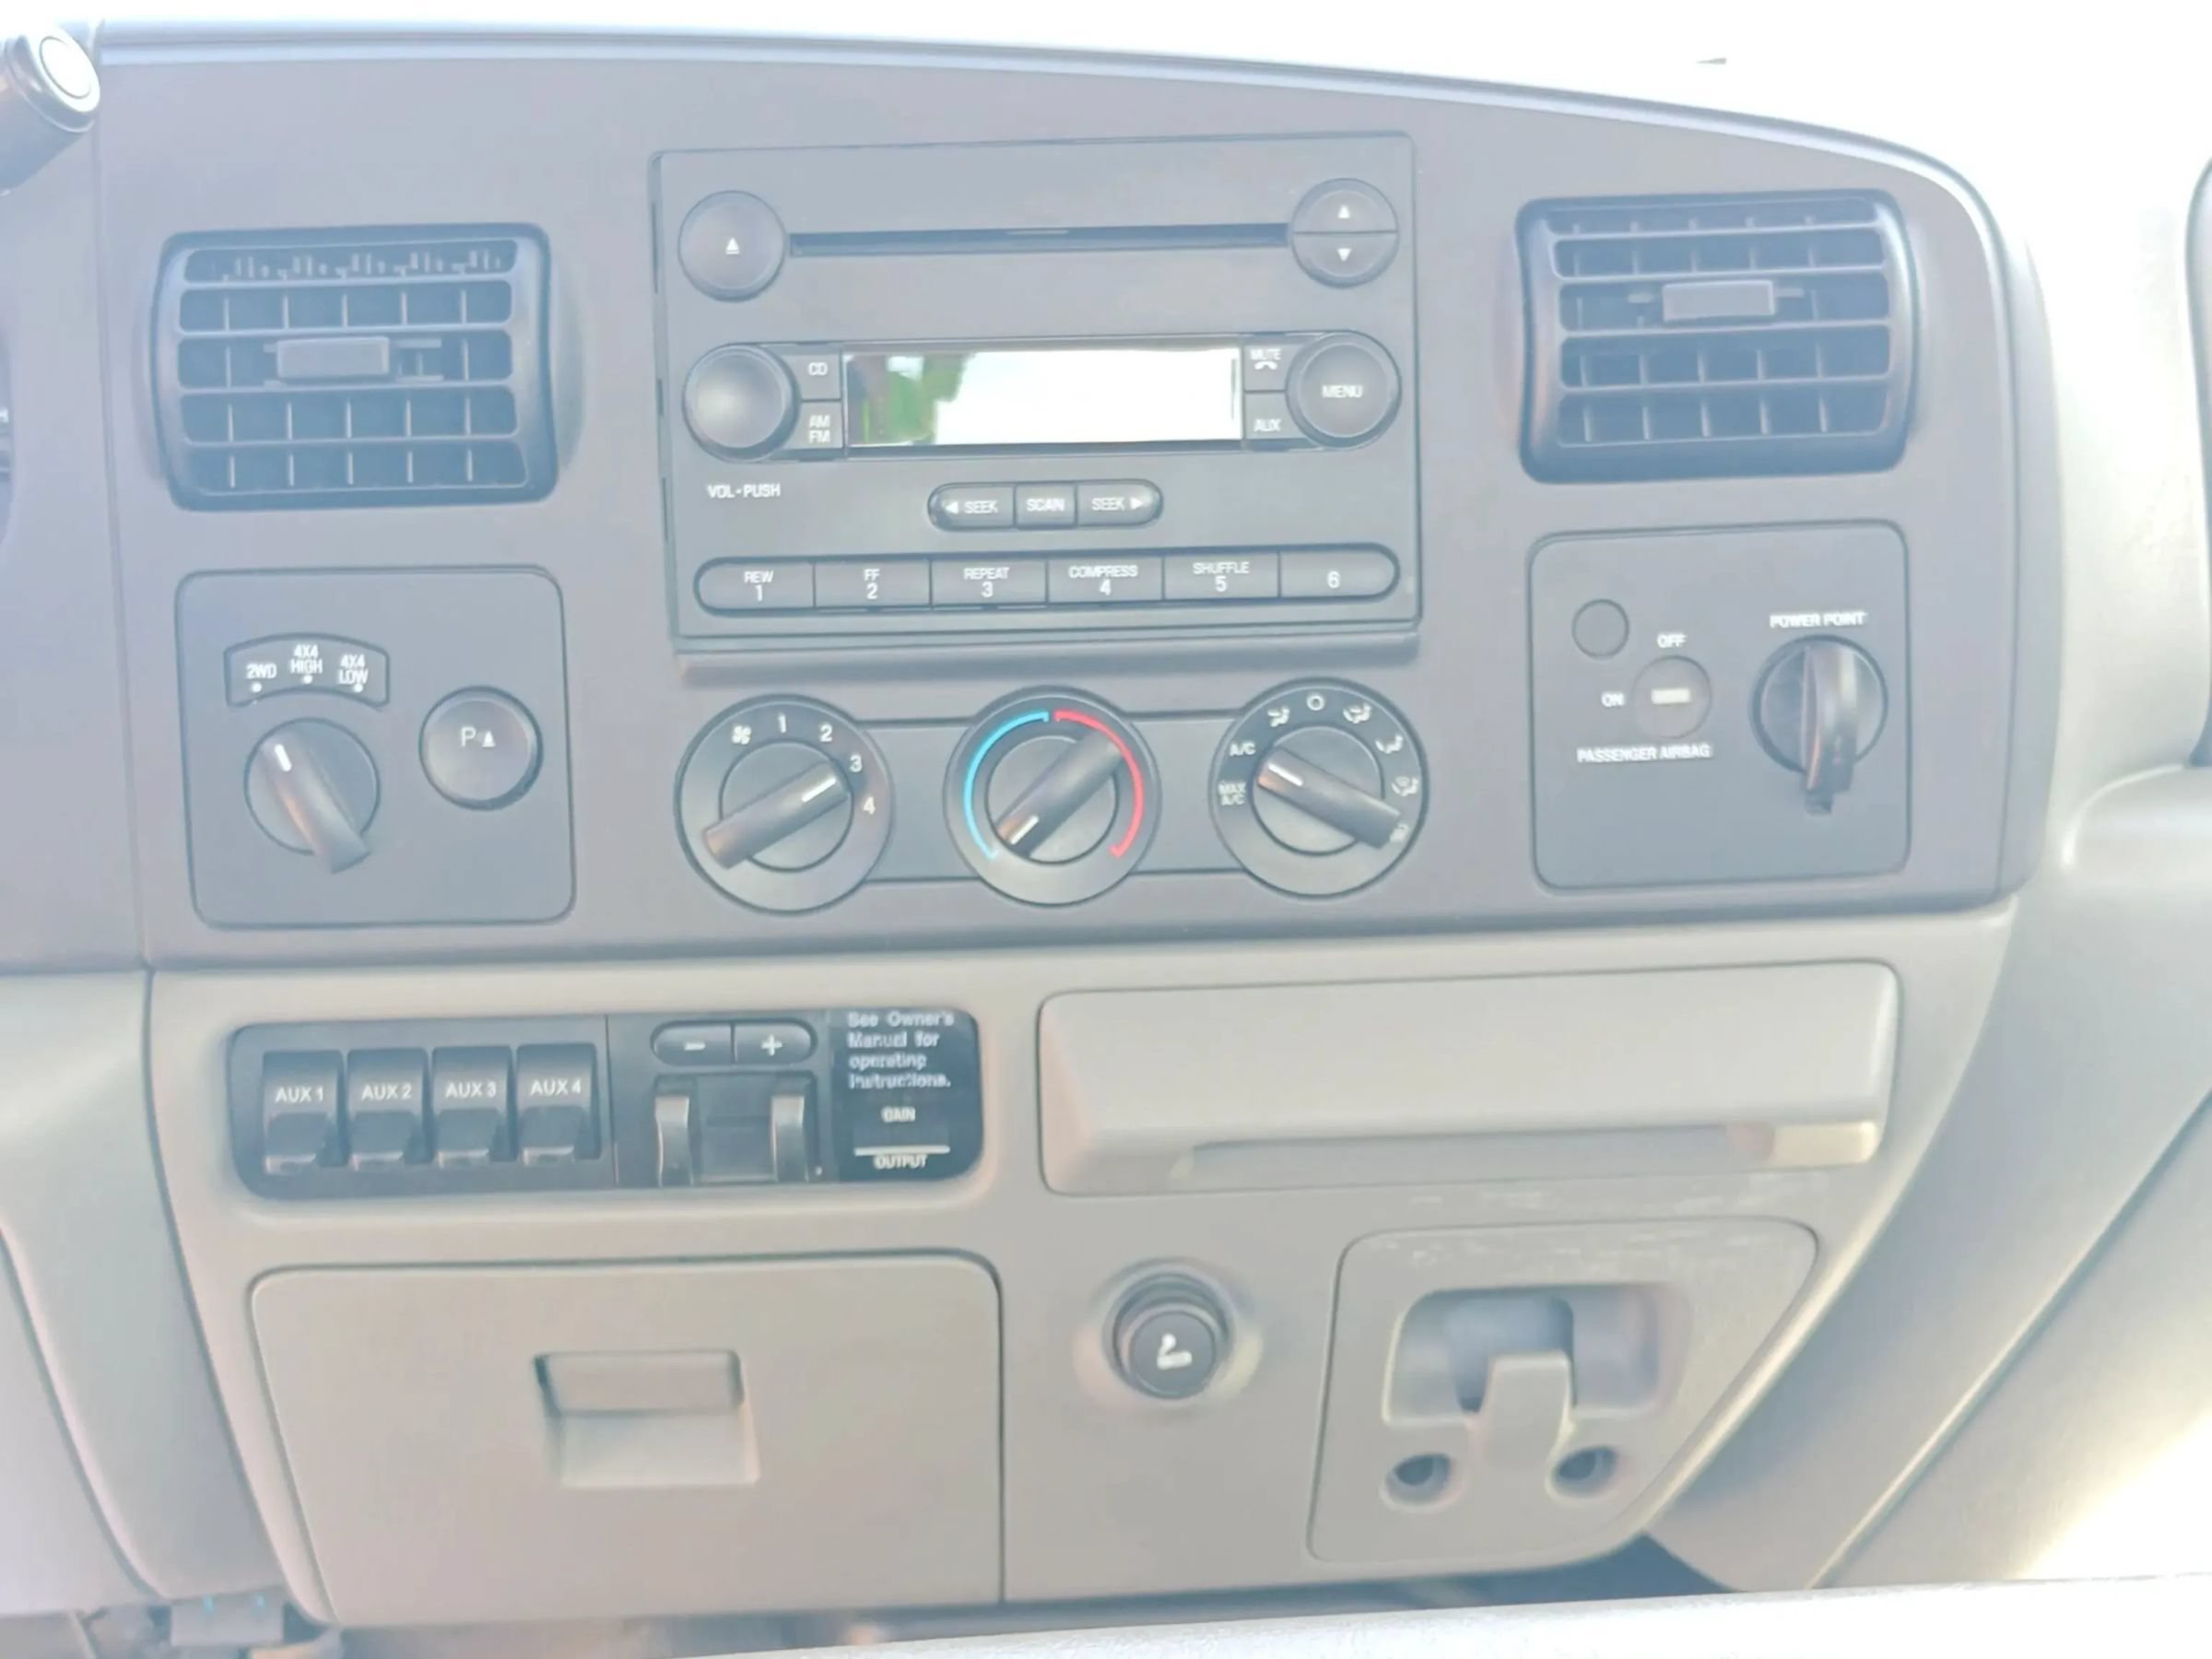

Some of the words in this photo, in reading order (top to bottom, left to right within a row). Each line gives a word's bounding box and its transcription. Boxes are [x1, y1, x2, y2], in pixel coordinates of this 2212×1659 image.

[808, 362, 828, 375] CD
[1322, 385, 1363, 398] MENU
[809, 415, 830, 428] AM
[1253, 418, 1281, 432] AUX
[809, 429, 830, 442] FM
[964, 500, 998, 514] SEEK
[1026, 499, 1065, 512] SCAN
[1092, 497, 1124, 511] SEEK
[864, 569, 880, 582] FF
[964, 567, 1009, 580] REPEAT
[1068, 565, 1139, 579] COMPRESS
[1193, 562, 1250, 575] SHUFFLE
[744, 571, 773, 583] REW
[1215, 575, 1228, 592] 5
[1327, 571, 1341, 589] 6
[755, 584, 763, 601] 1
[866, 582, 878, 600] 2
[982, 581, 993, 597] 3
[1100, 580, 1112, 596] 4
[1770, 613, 1820, 628] POWER
[1824, 611, 1867, 626] POINT
[1657, 634, 1686, 648] OFF
[294, 644, 318, 658] 4X4
[290, 659, 323, 675] HIGH
[340, 654, 365, 668] 4X4
[246, 664, 276, 679] 2WD
[338, 669, 368, 684] LOW
[1602, 692, 1625, 707] ON
[777, 712, 786, 734] 1
[819, 722, 833, 743] 2
[1230, 741, 1255, 756] A/C
[1577, 747, 1657, 762] PASSENGER
[1661, 744, 1712, 759] AIRBAG
[849, 752, 863, 773] 3
[863, 793, 876, 815] 4
[1221, 795, 1245, 806] A/C
[847, 1011, 878, 1028] See
[887, 1011, 954, 1027] Owner's
[847, 1031, 907, 1048] Manual
[914, 1031, 940, 1047] for
[849, 1052, 927, 1071] operating
[275, 1087, 312, 1103] AUX
[316, 1087, 324, 1101] 1
[360, 1085, 399, 1101] AUX
[401, 1085, 412, 1100] 2
[444, 1082, 484, 1099] AUX
[486, 1082, 498, 1098] 3
[530, 1080, 569, 1097] AUX
[571, 1079, 582, 1095] 4
[874, 1155, 928, 1169] OUTPUT
